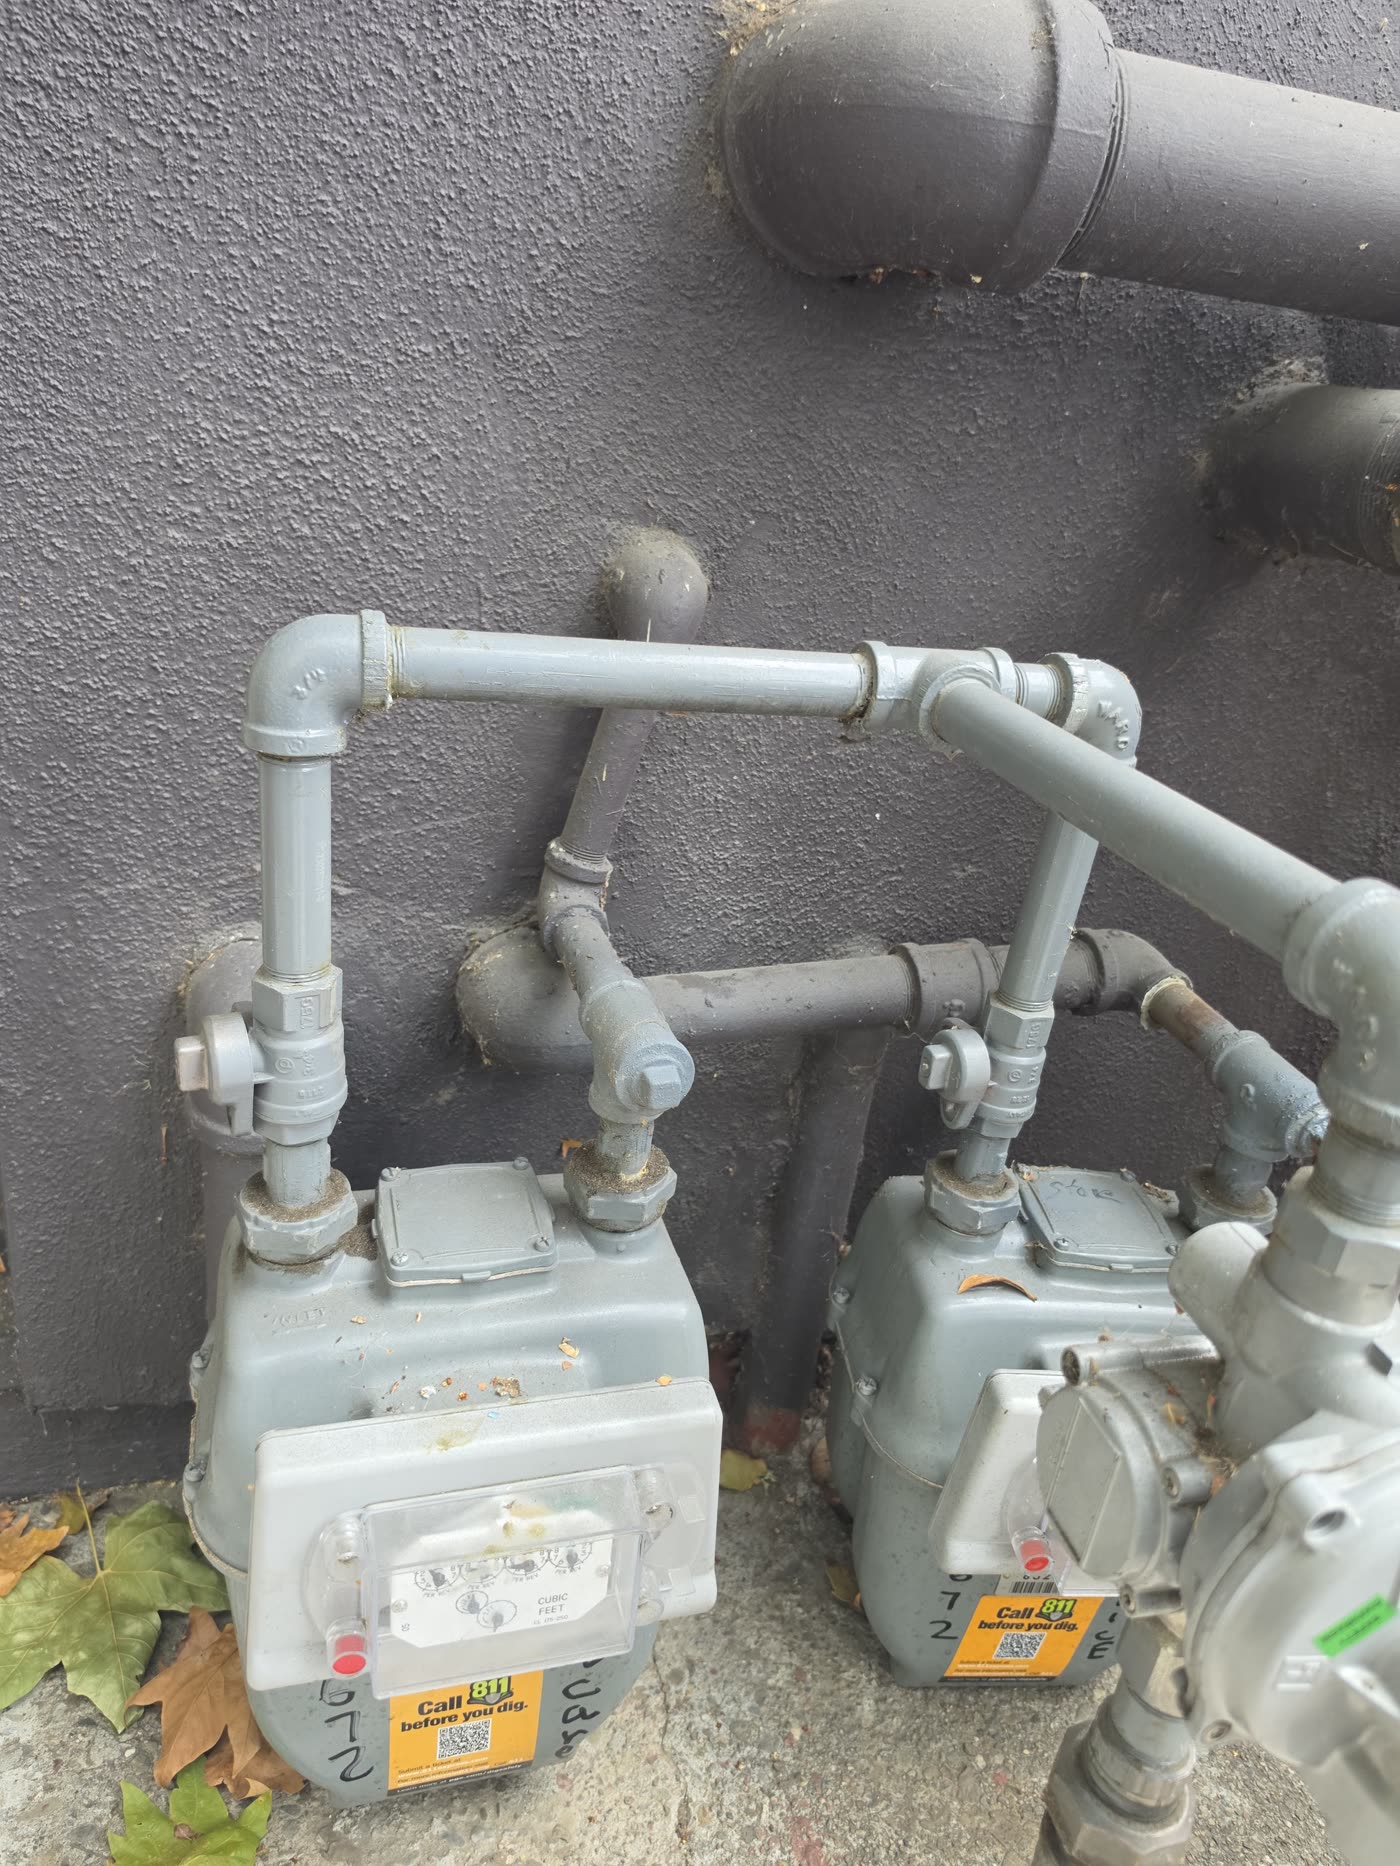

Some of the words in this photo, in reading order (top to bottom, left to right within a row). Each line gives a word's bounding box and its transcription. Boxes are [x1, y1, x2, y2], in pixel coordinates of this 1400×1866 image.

[537, 1592, 569, 1606] CUBIC
[538, 1603, 566, 1616] FEET
[996, 1606, 1034, 1620] Call
[1041, 1599, 1077, 1614] 811
[977, 1620, 1024, 1631] before
[1024, 1622, 1053, 1632] you
[1053, 1620, 1079, 1632] dig.
[417, 1694, 463, 1717] Call
[470, 1675, 512, 1700] 811
[401, 1712, 459, 1733] before
[462, 1706, 494, 1723] you
[496, 1700, 529, 1713] dig.
